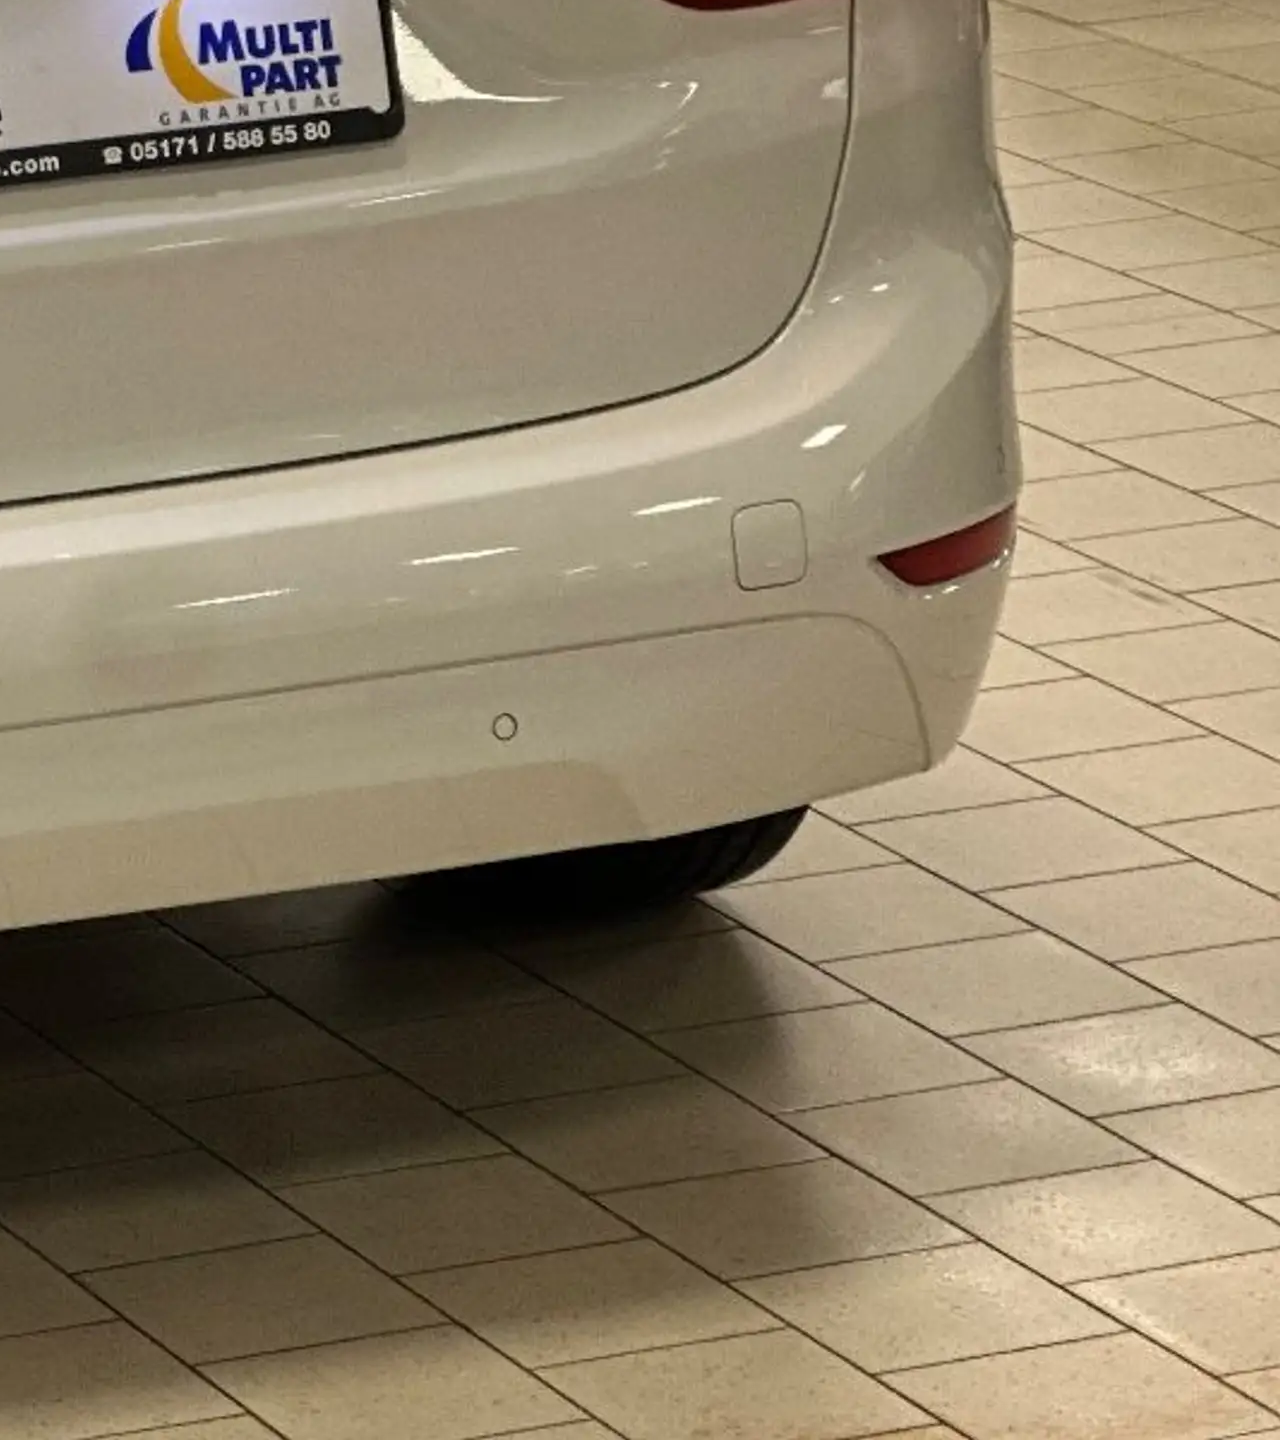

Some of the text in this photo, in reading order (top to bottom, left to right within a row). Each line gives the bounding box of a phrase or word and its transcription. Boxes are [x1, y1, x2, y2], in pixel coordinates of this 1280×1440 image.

[197, 18, 334, 65] MULTI
[240, 55, 343, 98] PART
[158, 91, 341, 127] GARANTIE AG
[129, 135, 199, 162] 05171
[223, 127, 264, 151] 588
[270, 124, 298, 145] 55
[303, 120, 332, 141] 80
